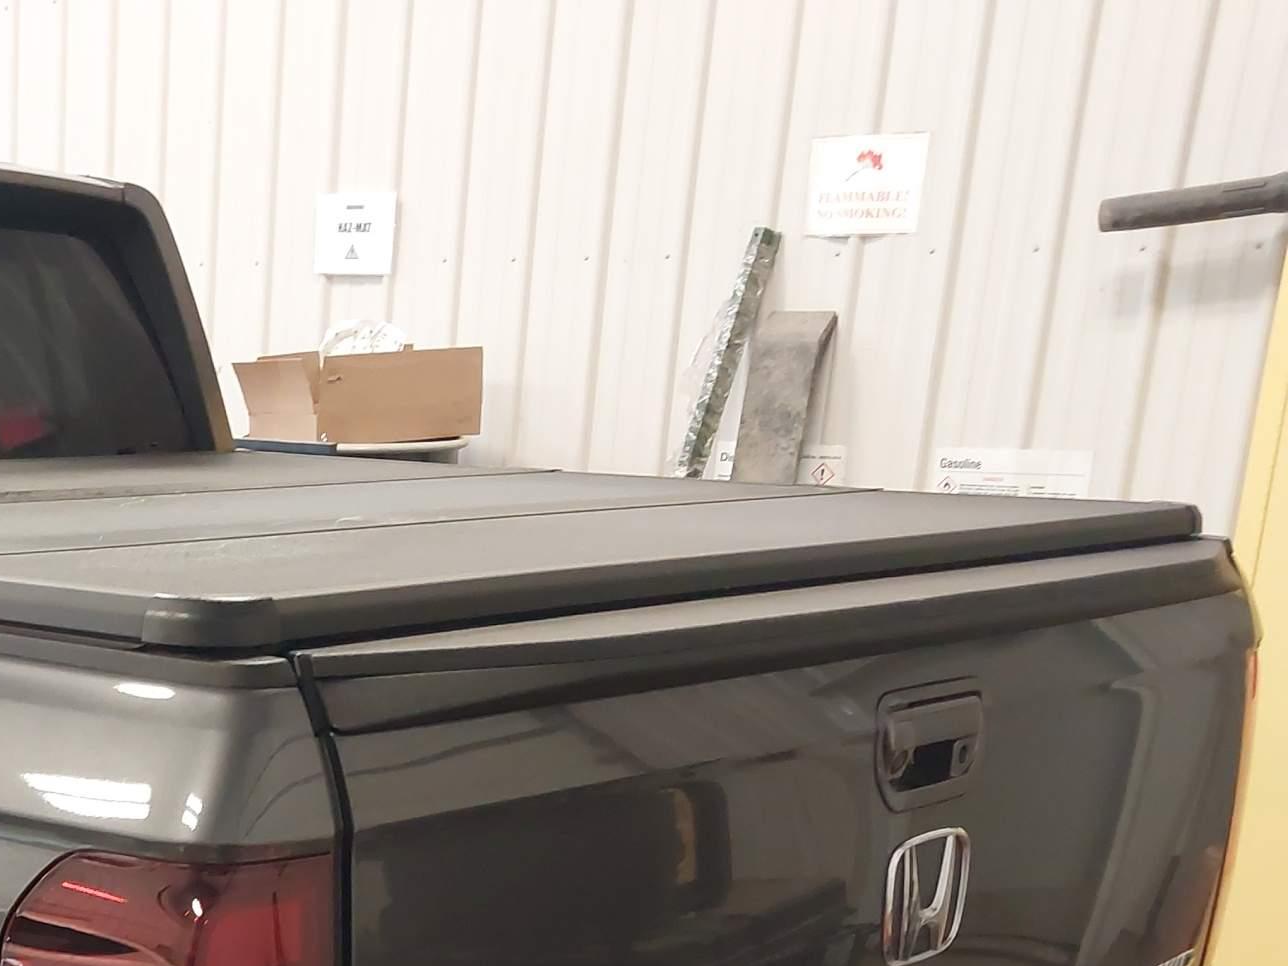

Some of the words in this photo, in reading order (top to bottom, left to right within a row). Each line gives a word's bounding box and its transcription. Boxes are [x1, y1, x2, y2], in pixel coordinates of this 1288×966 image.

[818, 189, 910, 204] FLAMMABLE!
[837, 206, 907, 219] SMOKING!
[939, 457, 983, 470] Gasoline
